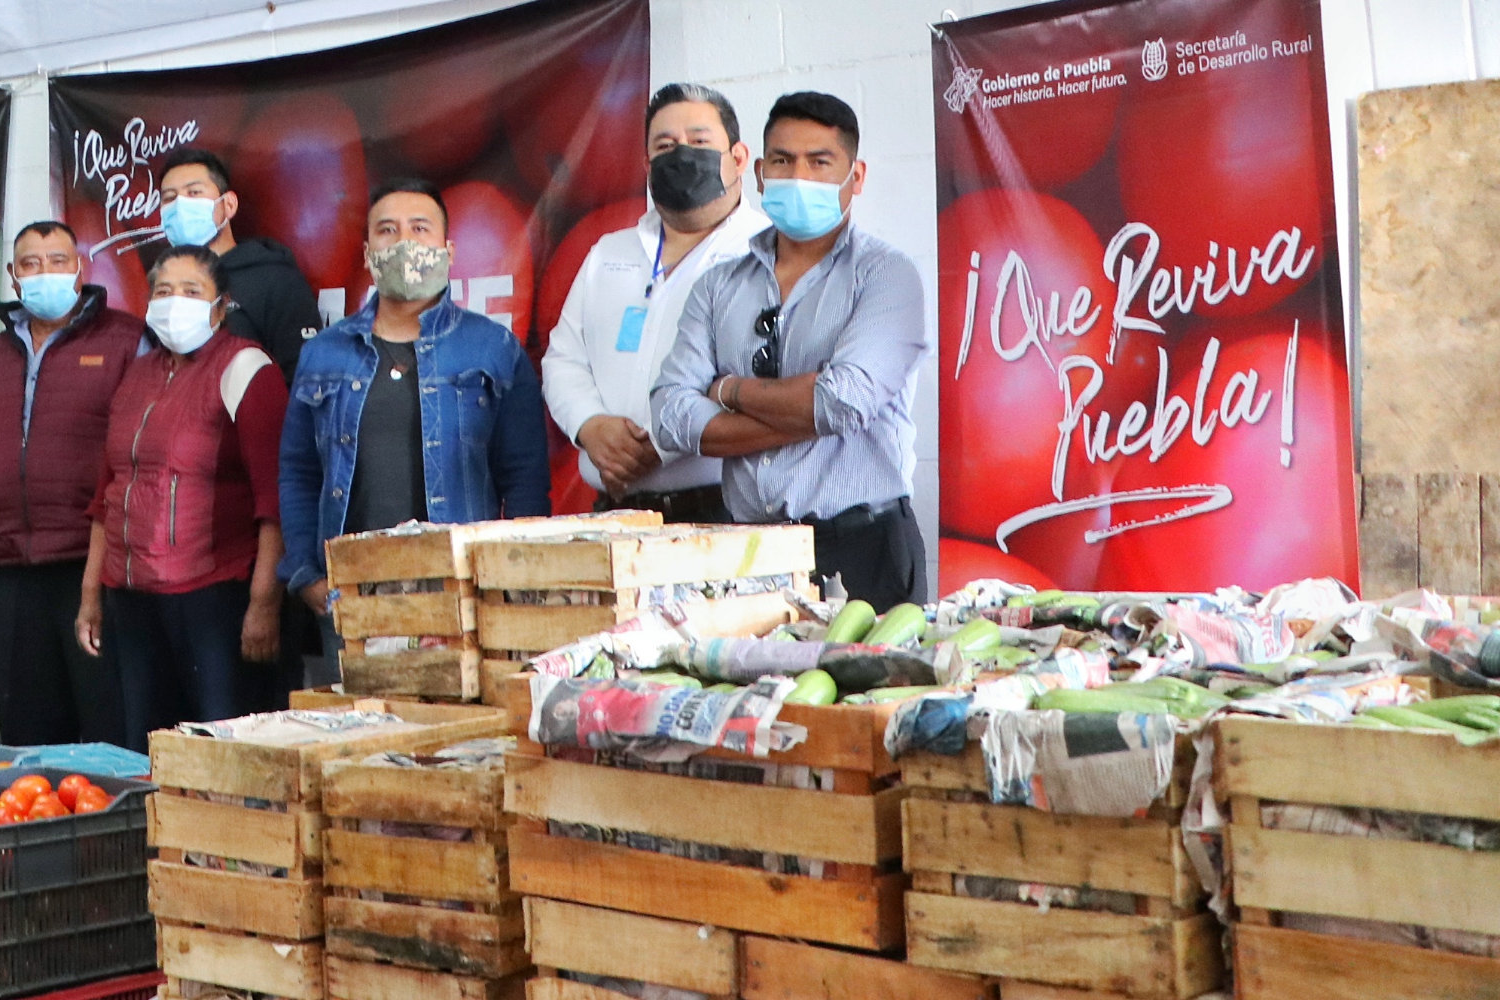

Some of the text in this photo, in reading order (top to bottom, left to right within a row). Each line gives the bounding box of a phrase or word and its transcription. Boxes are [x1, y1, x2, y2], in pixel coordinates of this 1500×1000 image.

[1175, 30, 1247, 58] Secretaría
[1177, 34, 1312, 76] de Desarrollo Rural
[982, 56, 1111, 94] Gobierno de Puebla
[982, 74, 1127, 110] Hacer historia. Hacer futuro.
[73, 117, 199, 188] ¡Que Reviva
[105, 169, 161, 237] Pueb
[955, 222, 1315, 381] ¡Que Reviva
[1051, 318, 1299, 503] Puebla!
